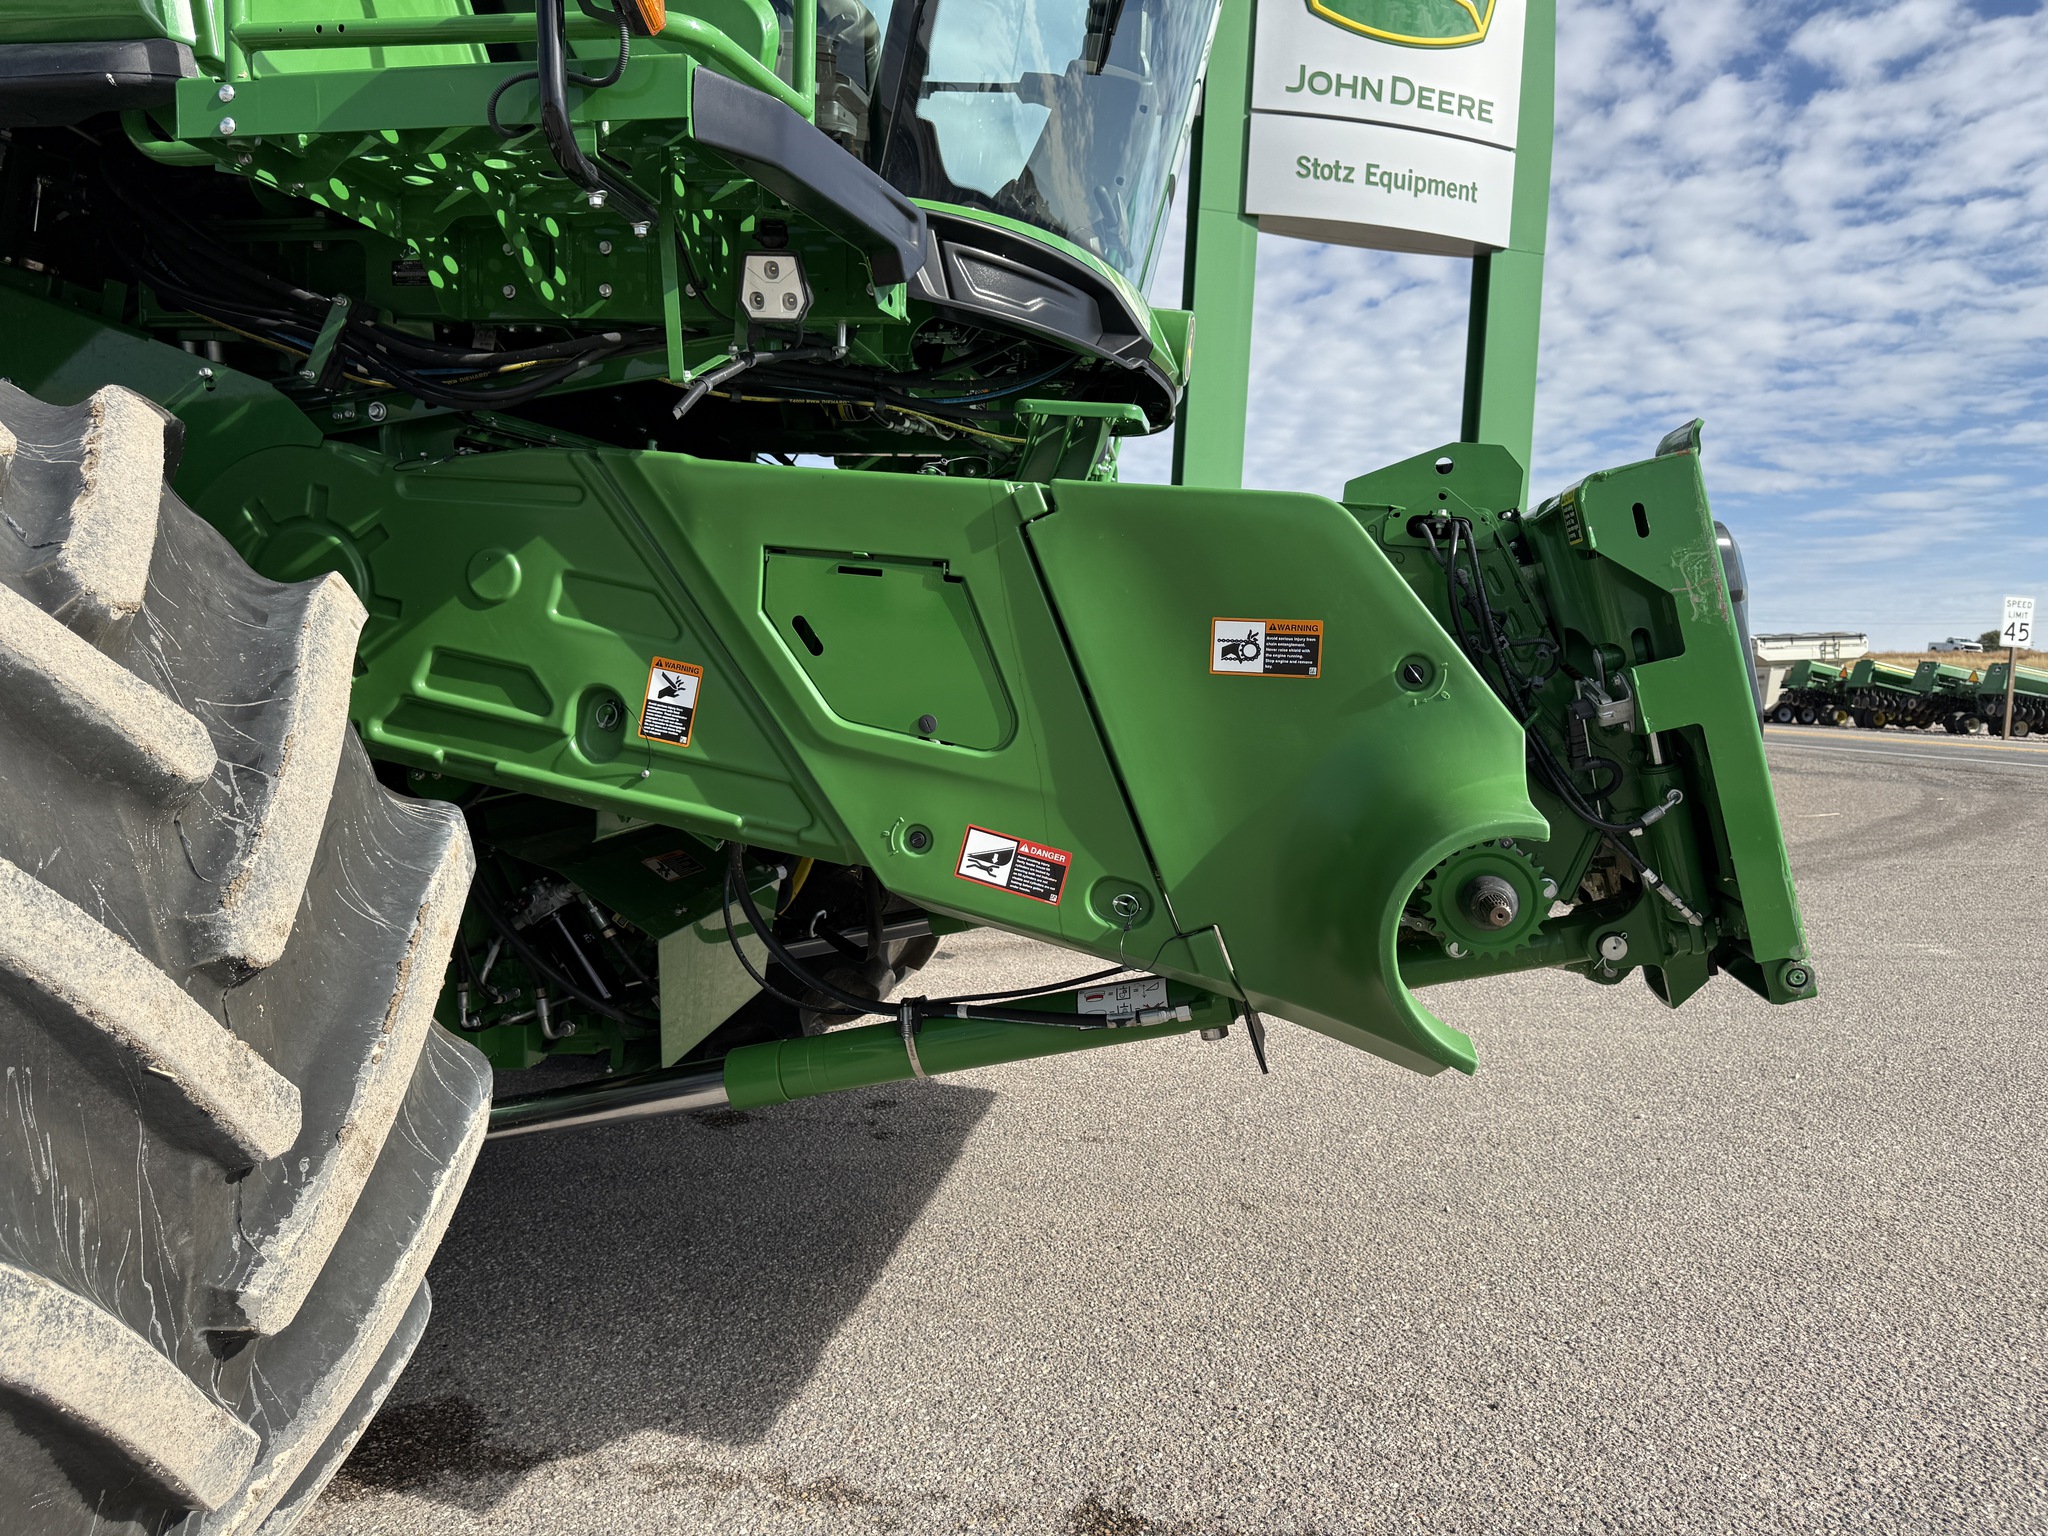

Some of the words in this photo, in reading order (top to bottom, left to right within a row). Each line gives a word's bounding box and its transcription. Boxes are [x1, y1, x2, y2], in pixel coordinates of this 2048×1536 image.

[1285, 64, 1384, 103] JOHN
[1390, 75, 1494, 124] DEERE
[1295, 155, 1355, 184] Stotz
[1365, 162, 1478, 203] Equipment
[2006, 599, 2032, 609] SPEED
[2008, 611, 2028, 619] LIMIT
[1277, 623, 1319, 632] WARNING
[2004, 621, 2029, 641] 45
[664, 661, 699, 675] WARNING
[1030, 847, 1065, 862] DANGER
